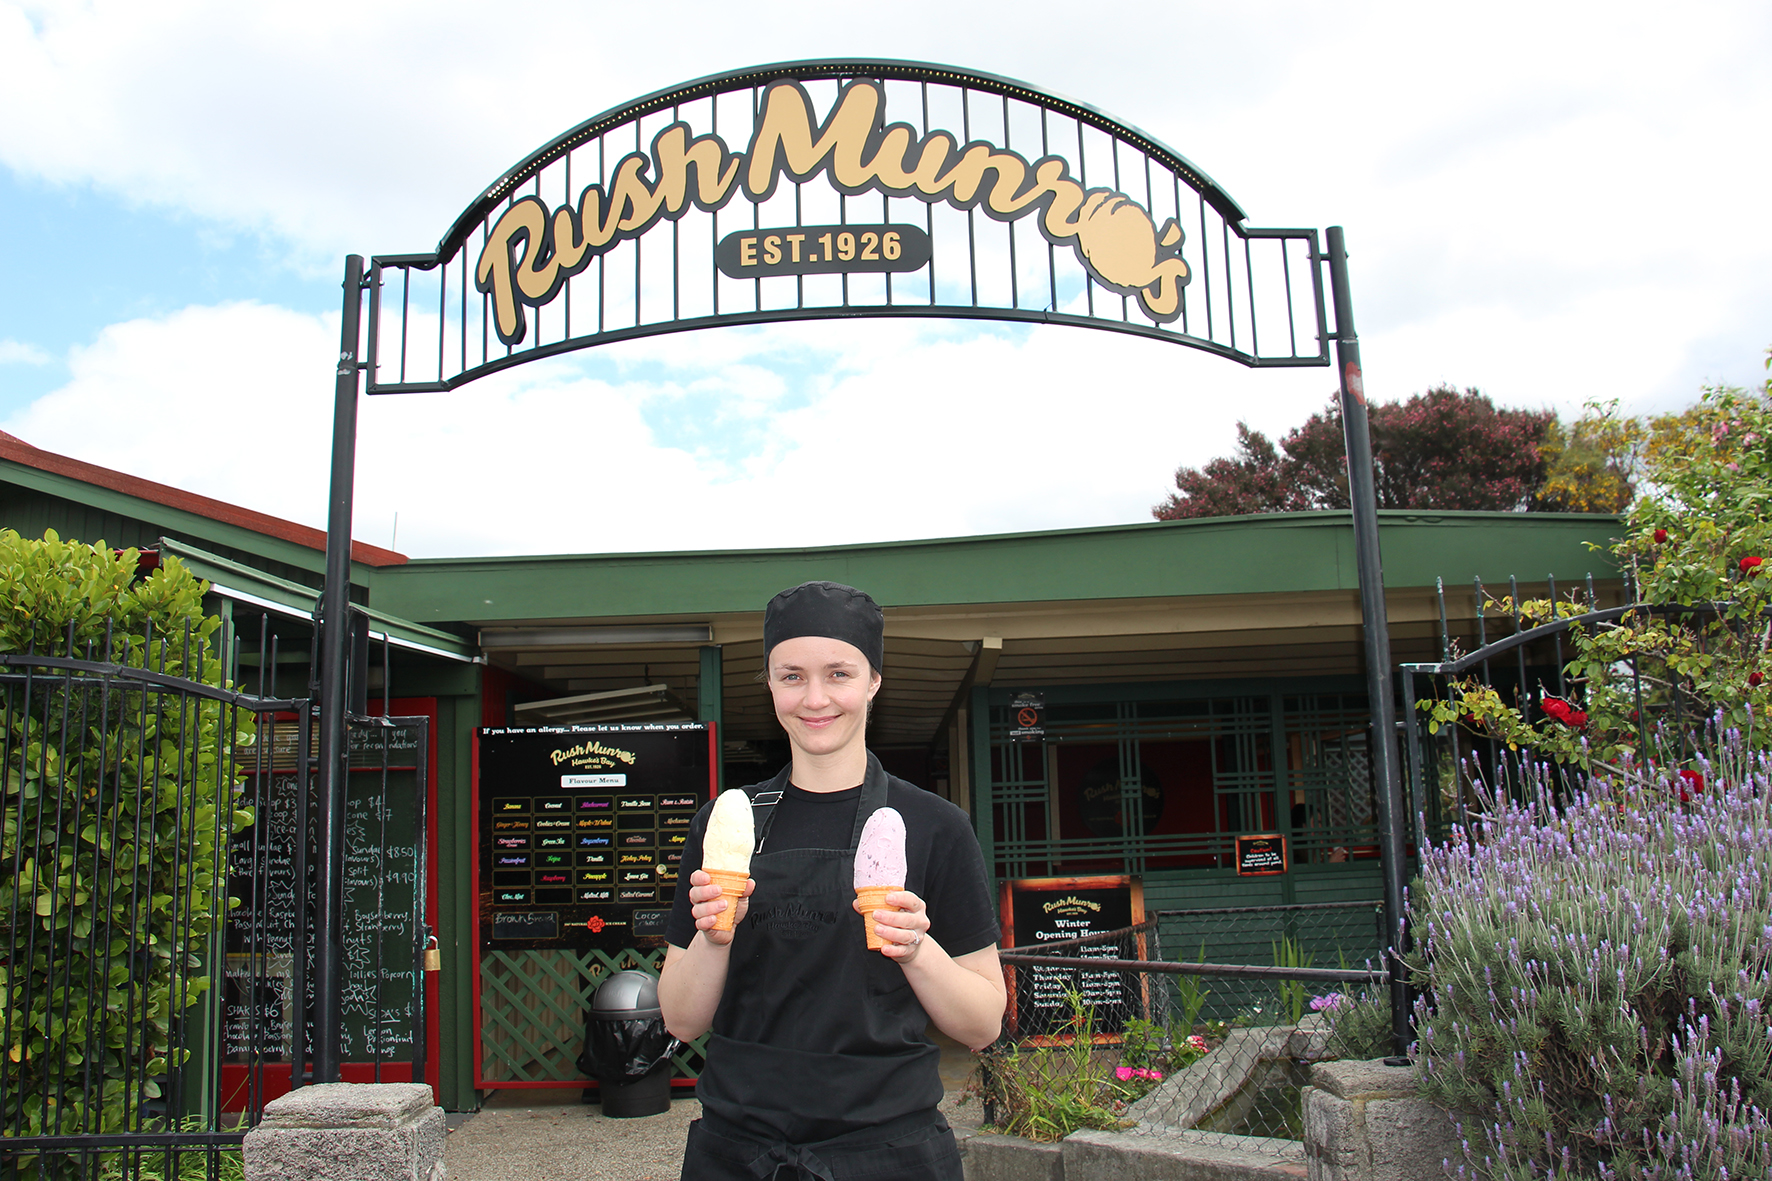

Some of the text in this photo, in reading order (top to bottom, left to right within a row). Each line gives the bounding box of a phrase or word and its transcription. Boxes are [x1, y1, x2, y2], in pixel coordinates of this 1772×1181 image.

[478, 83, 1187, 338] Rush Munro's
[572, 725, 597, 733] Please
[598, 724, 608, 732] let
[644, 723, 665, 731] when
[665, 724, 680, 732] you
[681, 722, 704, 730] order.
[550, 741, 637, 766] Rush Munro's
[600, 756, 616, 768] Bay
[234, 854, 253, 869] Larg
[347, 865, 369, 877] Split
[1042, 895, 1102, 914] Rush Munro's
[750, 905, 785, 930] Rush
[1055, 920, 1091, 928] Winter
[1036, 930, 1077, 940] Opening
[227, 1004, 261, 1017] SHAKS
[366, 1043, 396, 1058] Ornge
